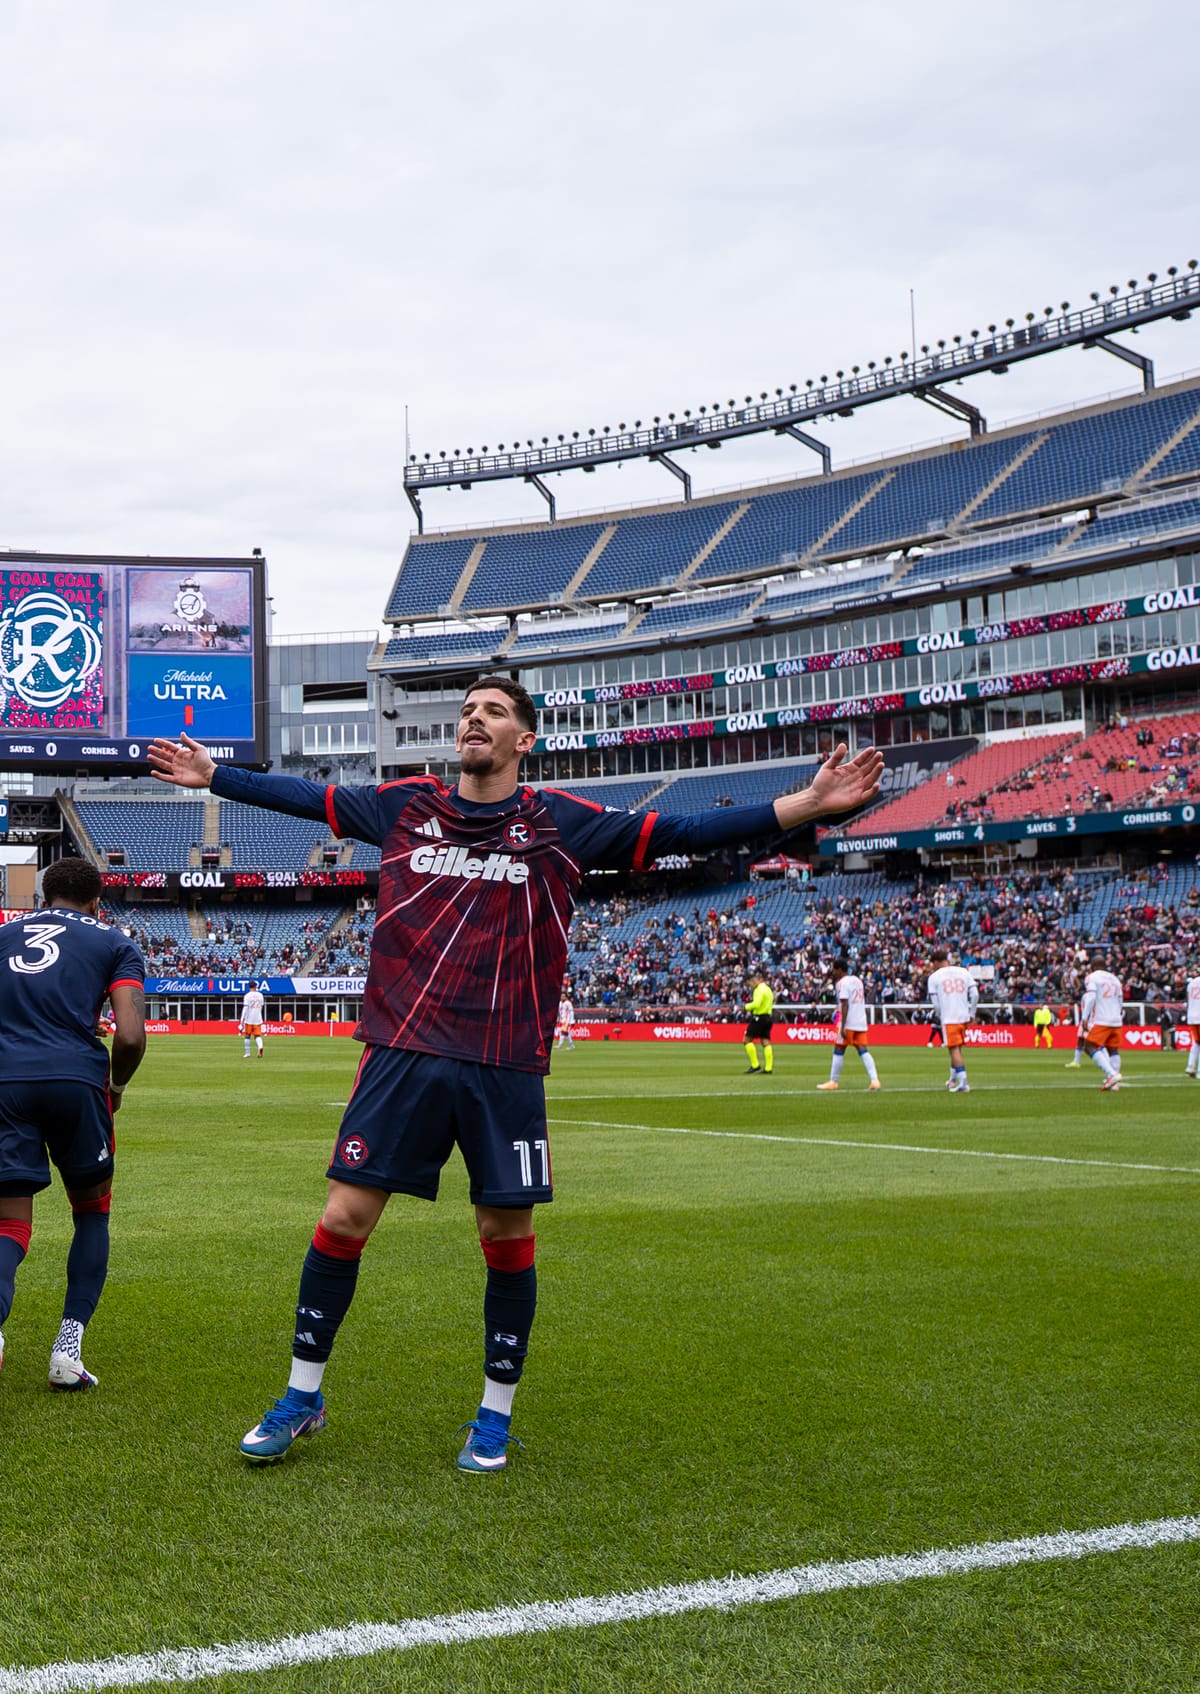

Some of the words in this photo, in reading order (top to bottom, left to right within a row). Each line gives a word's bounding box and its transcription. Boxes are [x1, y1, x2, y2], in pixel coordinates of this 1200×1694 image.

[9, 571, 51, 587] GOAL
[53, 573, 96, 588] GOAL
[1143, 586, 1199, 614] GOAL
[916, 630, 964, 653] GOAL
[1147, 645, 1200, 671] GOAL
[163, 669, 213, 683] Michelob
[724, 665, 766, 685] GOAL
[153, 684, 227, 701] ULTRA
[544, 690, 587, 707] GOAL
[918, 683, 967, 706] GOAL
[8, 712, 50, 728] GOAL
[53, 713, 95, 729] GOAL
[726, 713, 767, 732] GOAL
[9, 745, 35, 753] SAVES:
[45, 742, 57, 756] 0
[81, 746, 119, 756] CORNERS:
[128, 744, 140, 758] 0
[545, 734, 588, 751] GOAL
[836, 837, 897, 853] REVOLUTION
[935, 830, 964, 843] SHOTS:
[974, 825, 984, 841] 4
[1026, 822, 1057, 834] SAVES:
[1066, 817, 1076, 832] 3
[1123, 811, 1172, 825] CORNERS:
[1182, 806, 1195, 822] 0
[409, 846, 530, 885] Gillette
[180, 872, 225, 887] GOAL
[8, 923, 67, 974] 3
[155, 979, 204, 994] Michelob
[310, 980, 366, 992] SUPERIO
[942, 978, 966, 994] 88
[513, 1139, 550, 1187] 11
